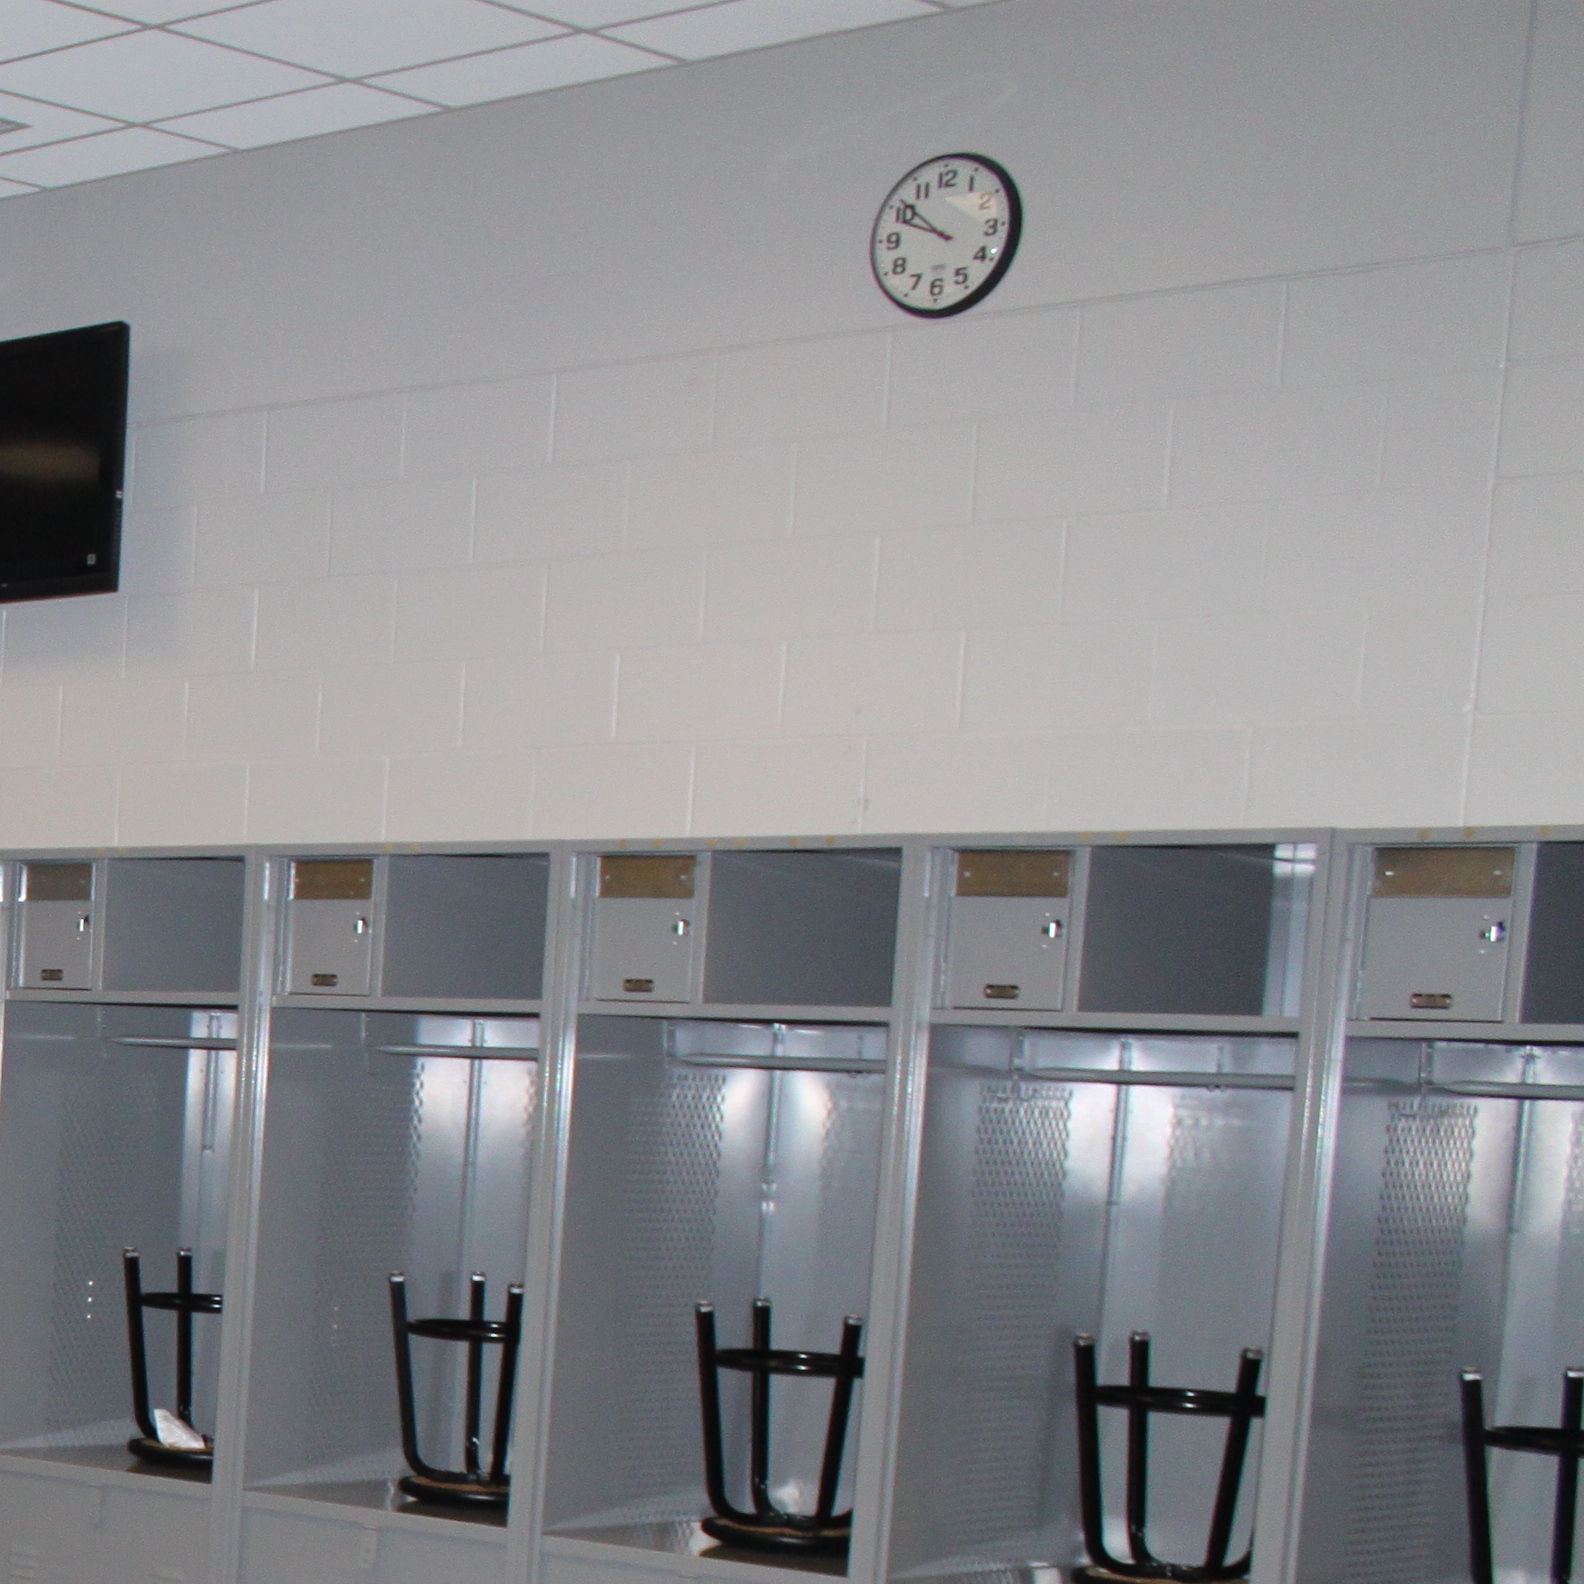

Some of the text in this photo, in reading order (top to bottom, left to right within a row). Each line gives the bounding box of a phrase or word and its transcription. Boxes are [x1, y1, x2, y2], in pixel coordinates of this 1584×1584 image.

[937, 169, 958, 188] 12
[968, 175, 975, 192] 1
[915, 182, 930, 200] 11
[978, 192, 992, 210] 2
[895, 204, 916, 223] 10
[984, 218, 998, 236] 3
[886, 232, 900, 250] 9
[973, 246, 987, 262] 4
[892, 257, 906, 275] 8
[909, 273, 923, 291] 7
[954, 267, 968, 285] 5
[930, 278, 944, 296] 6
